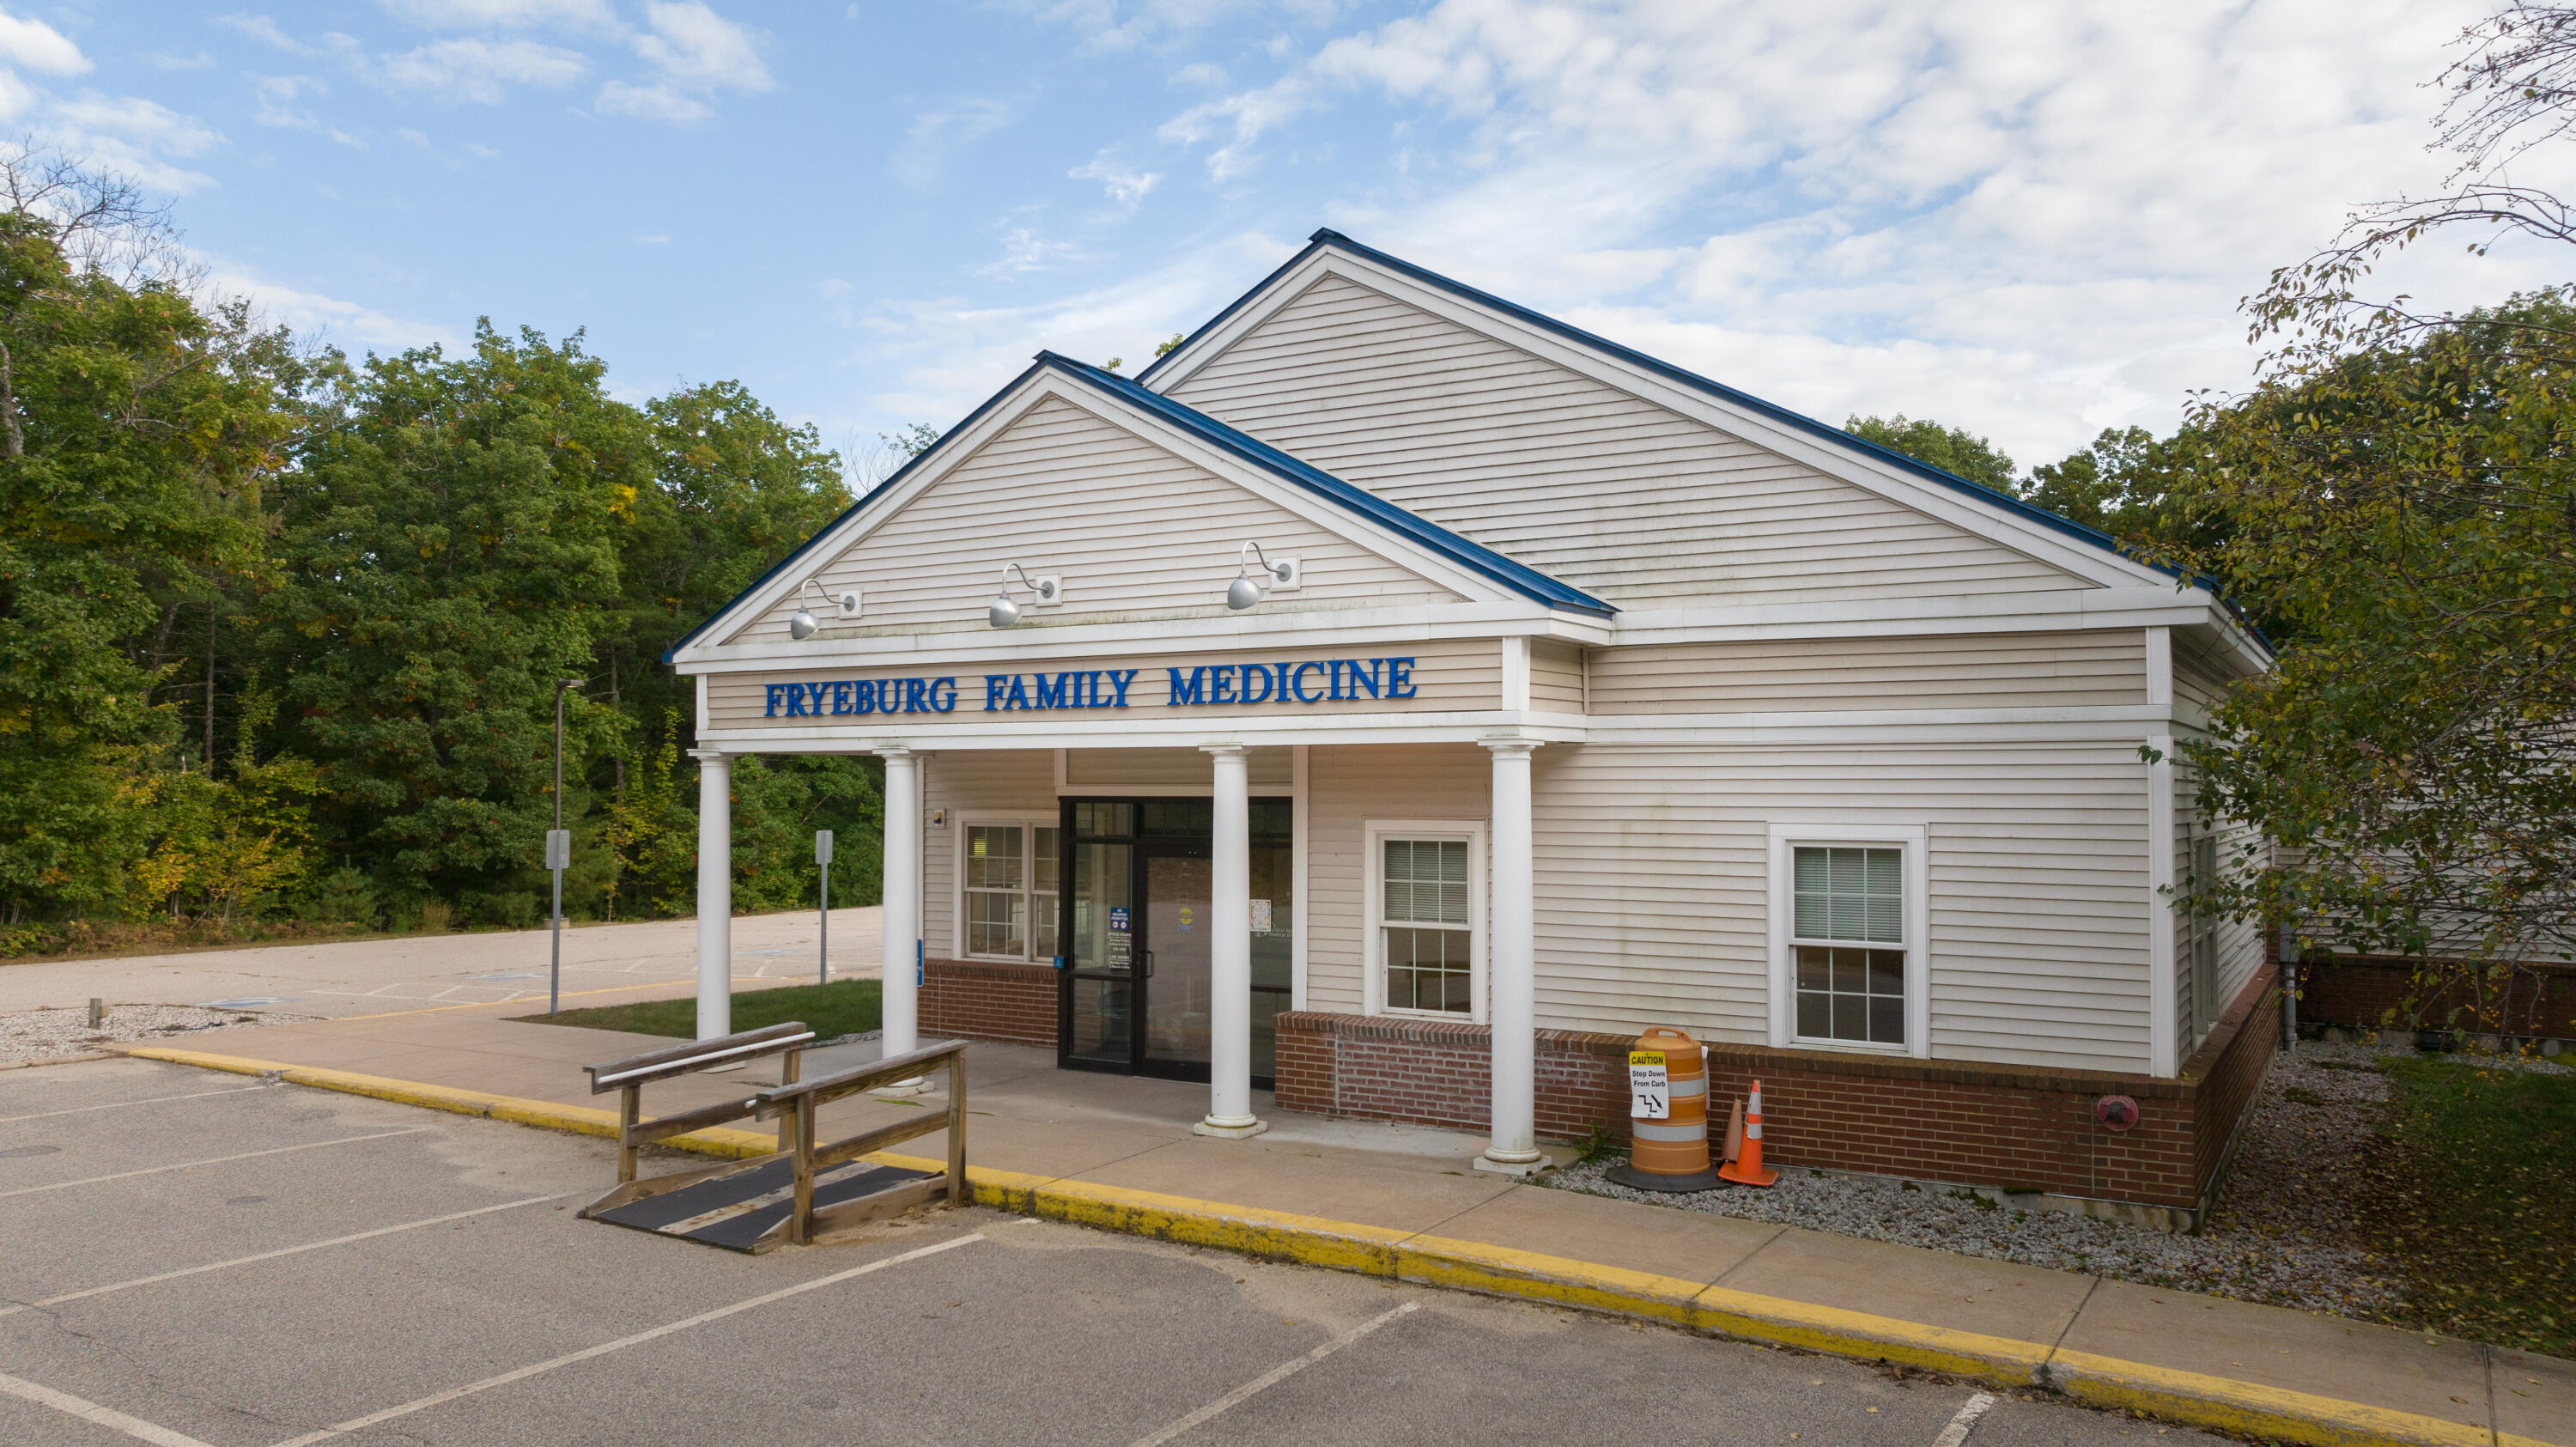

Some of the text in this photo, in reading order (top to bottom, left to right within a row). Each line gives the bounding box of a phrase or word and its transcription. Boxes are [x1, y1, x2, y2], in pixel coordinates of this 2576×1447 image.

[765, 657, 1418, 718] FRYEBURG FAMILY MEDICINE
